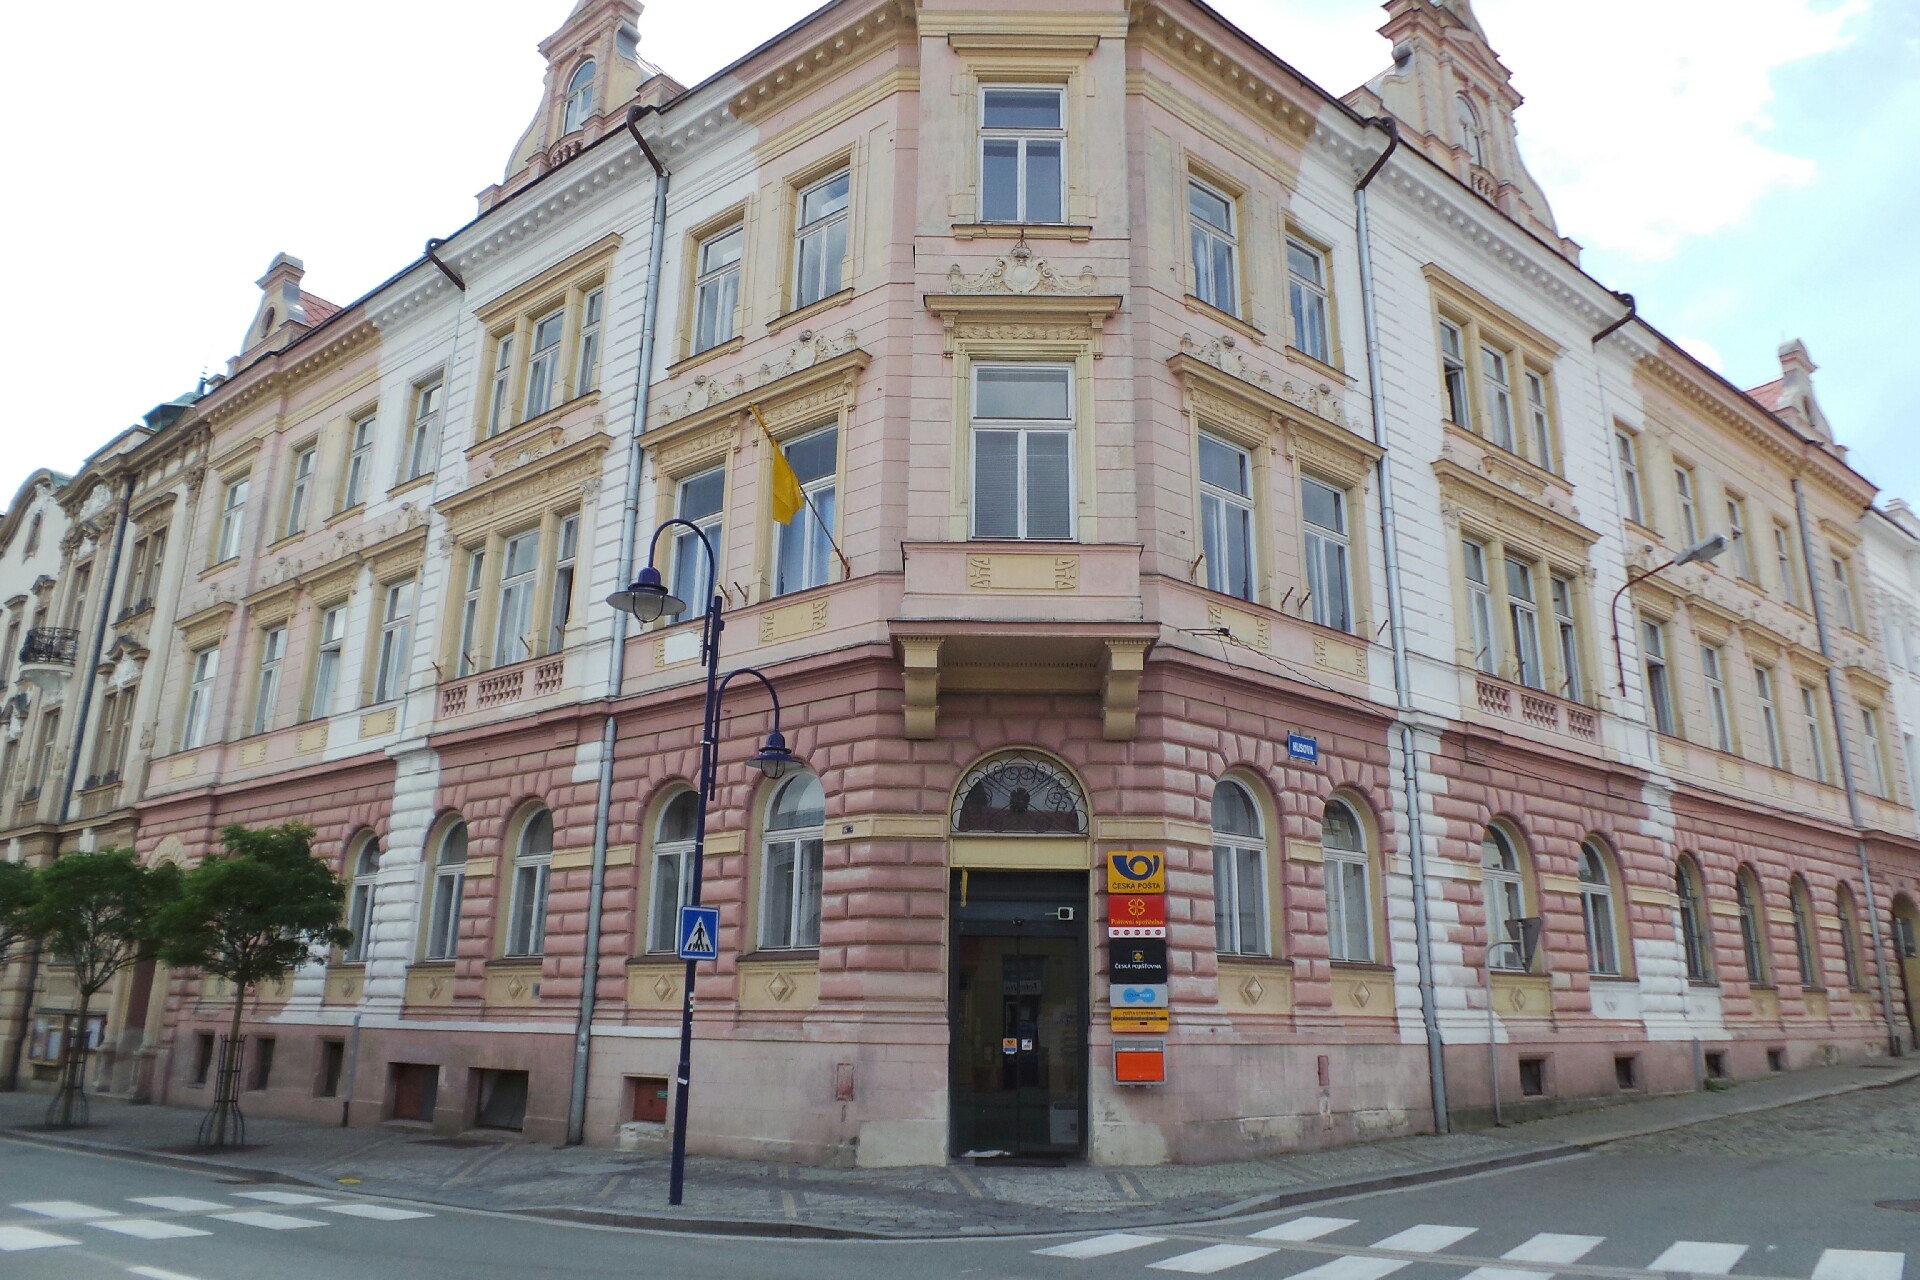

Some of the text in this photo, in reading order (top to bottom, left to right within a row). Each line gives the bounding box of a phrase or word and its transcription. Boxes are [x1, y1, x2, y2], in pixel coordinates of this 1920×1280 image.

[1292, 741, 1314, 756] HUSOVA
[1112, 881, 1161, 890] ČESKÁ POŠTA
